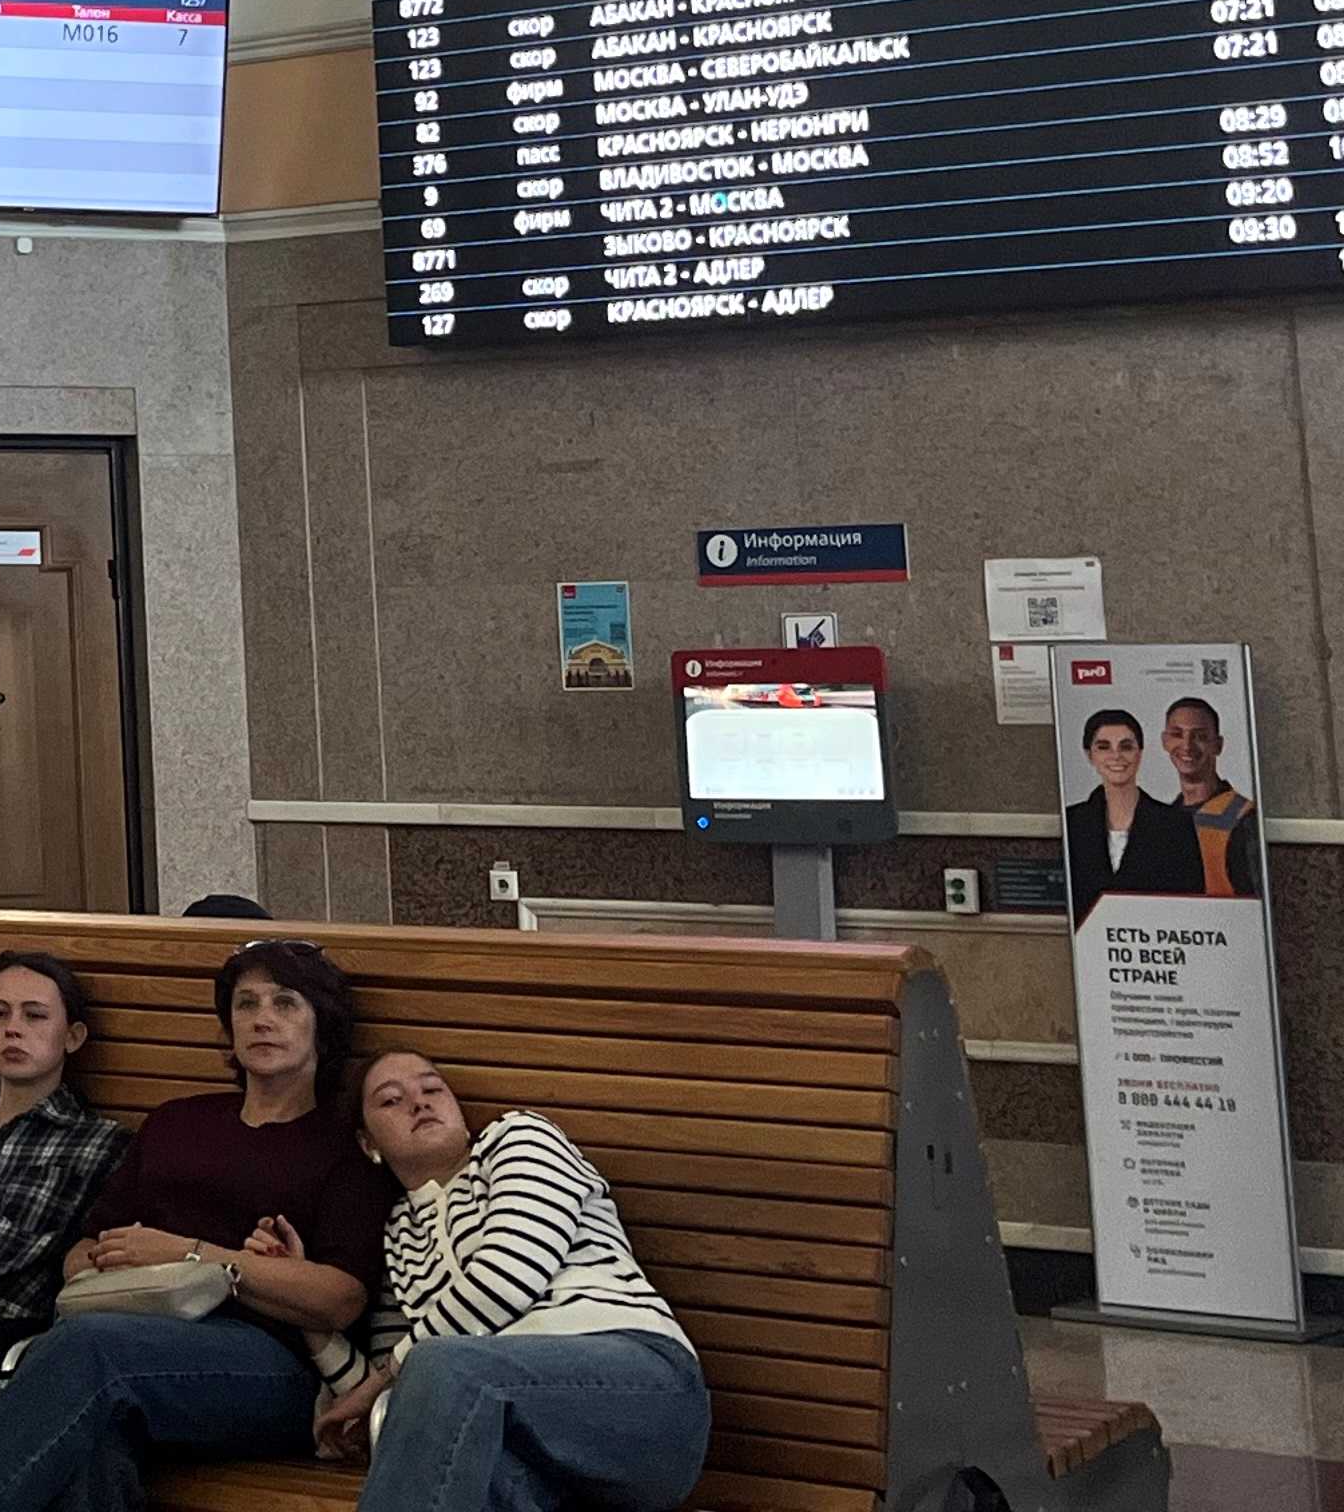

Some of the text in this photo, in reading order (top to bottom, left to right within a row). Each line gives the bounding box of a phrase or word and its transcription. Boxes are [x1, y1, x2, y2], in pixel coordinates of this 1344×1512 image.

[72, 4, 111, 19] Талон
[166, 9, 202, 23] Касса
[407, 26, 439, 48] 123
[507, 14, 554, 37] скор
[177, 29, 188, 46] 7
[408, 57, 441, 80] 123
[509, 47, 556, 69] скор
[591, 29, 676, 59] АБАКАН
[692, 10, 832, 47] КРАСНОЯРСК
[506, 78, 563, 105] фирм
[593, 62, 685, 91] МОСКВА
[700, 35, 910, 80] СЕВЕРОБАЙКАЛЬСК
[512, 112, 560, 134] скор
[595, 94, 687, 124] МОСКВА
[1213, 31, 1277, 59] 07:21
[516, 144, 560, 165] пасс
[597, 123, 734, 157] КРАСНОЯРСК
[516, 177, 563, 199] скор
[599, 155, 755, 190] ВЛАДИВОСТОК
[771, 144, 869, 174] МОСКВА
[1219, 104, 1287, 132] 08:29
[513, 209, 570, 234] фирм
[600, 198, 657, 222] ЧИТА
[689, 186, 784, 215] МОСКВА
[1222, 141, 1289, 169] 08:52
[603, 228, 692, 256] ЗЫКОВО
[708, 214, 850, 247] КРАСНОЯРСК
[1225, 178, 1293, 206] 09:20
[522, 276, 569, 298] скор
[604, 264, 661, 289] ЧИТА
[693, 256, 764, 285] АДЛЕР
[1228, 215, 1296, 243] 09:30
[421, 285, 833, 335] 127 скор КРАСНОЯРСК АДЛЕР
[743, 532, 863, 551] Информация
[745, 554, 817, 568] Information
[1106, 927, 1228, 947] ЕСТЬ РАБОТА
[1108, 947, 1186, 965] ПО ВСЕЙ
[1109, 968, 1179, 985] СТРАНЕ
[1164, 1094, 1190, 1109] 444
[1195, 1096, 1213, 1110] 44
